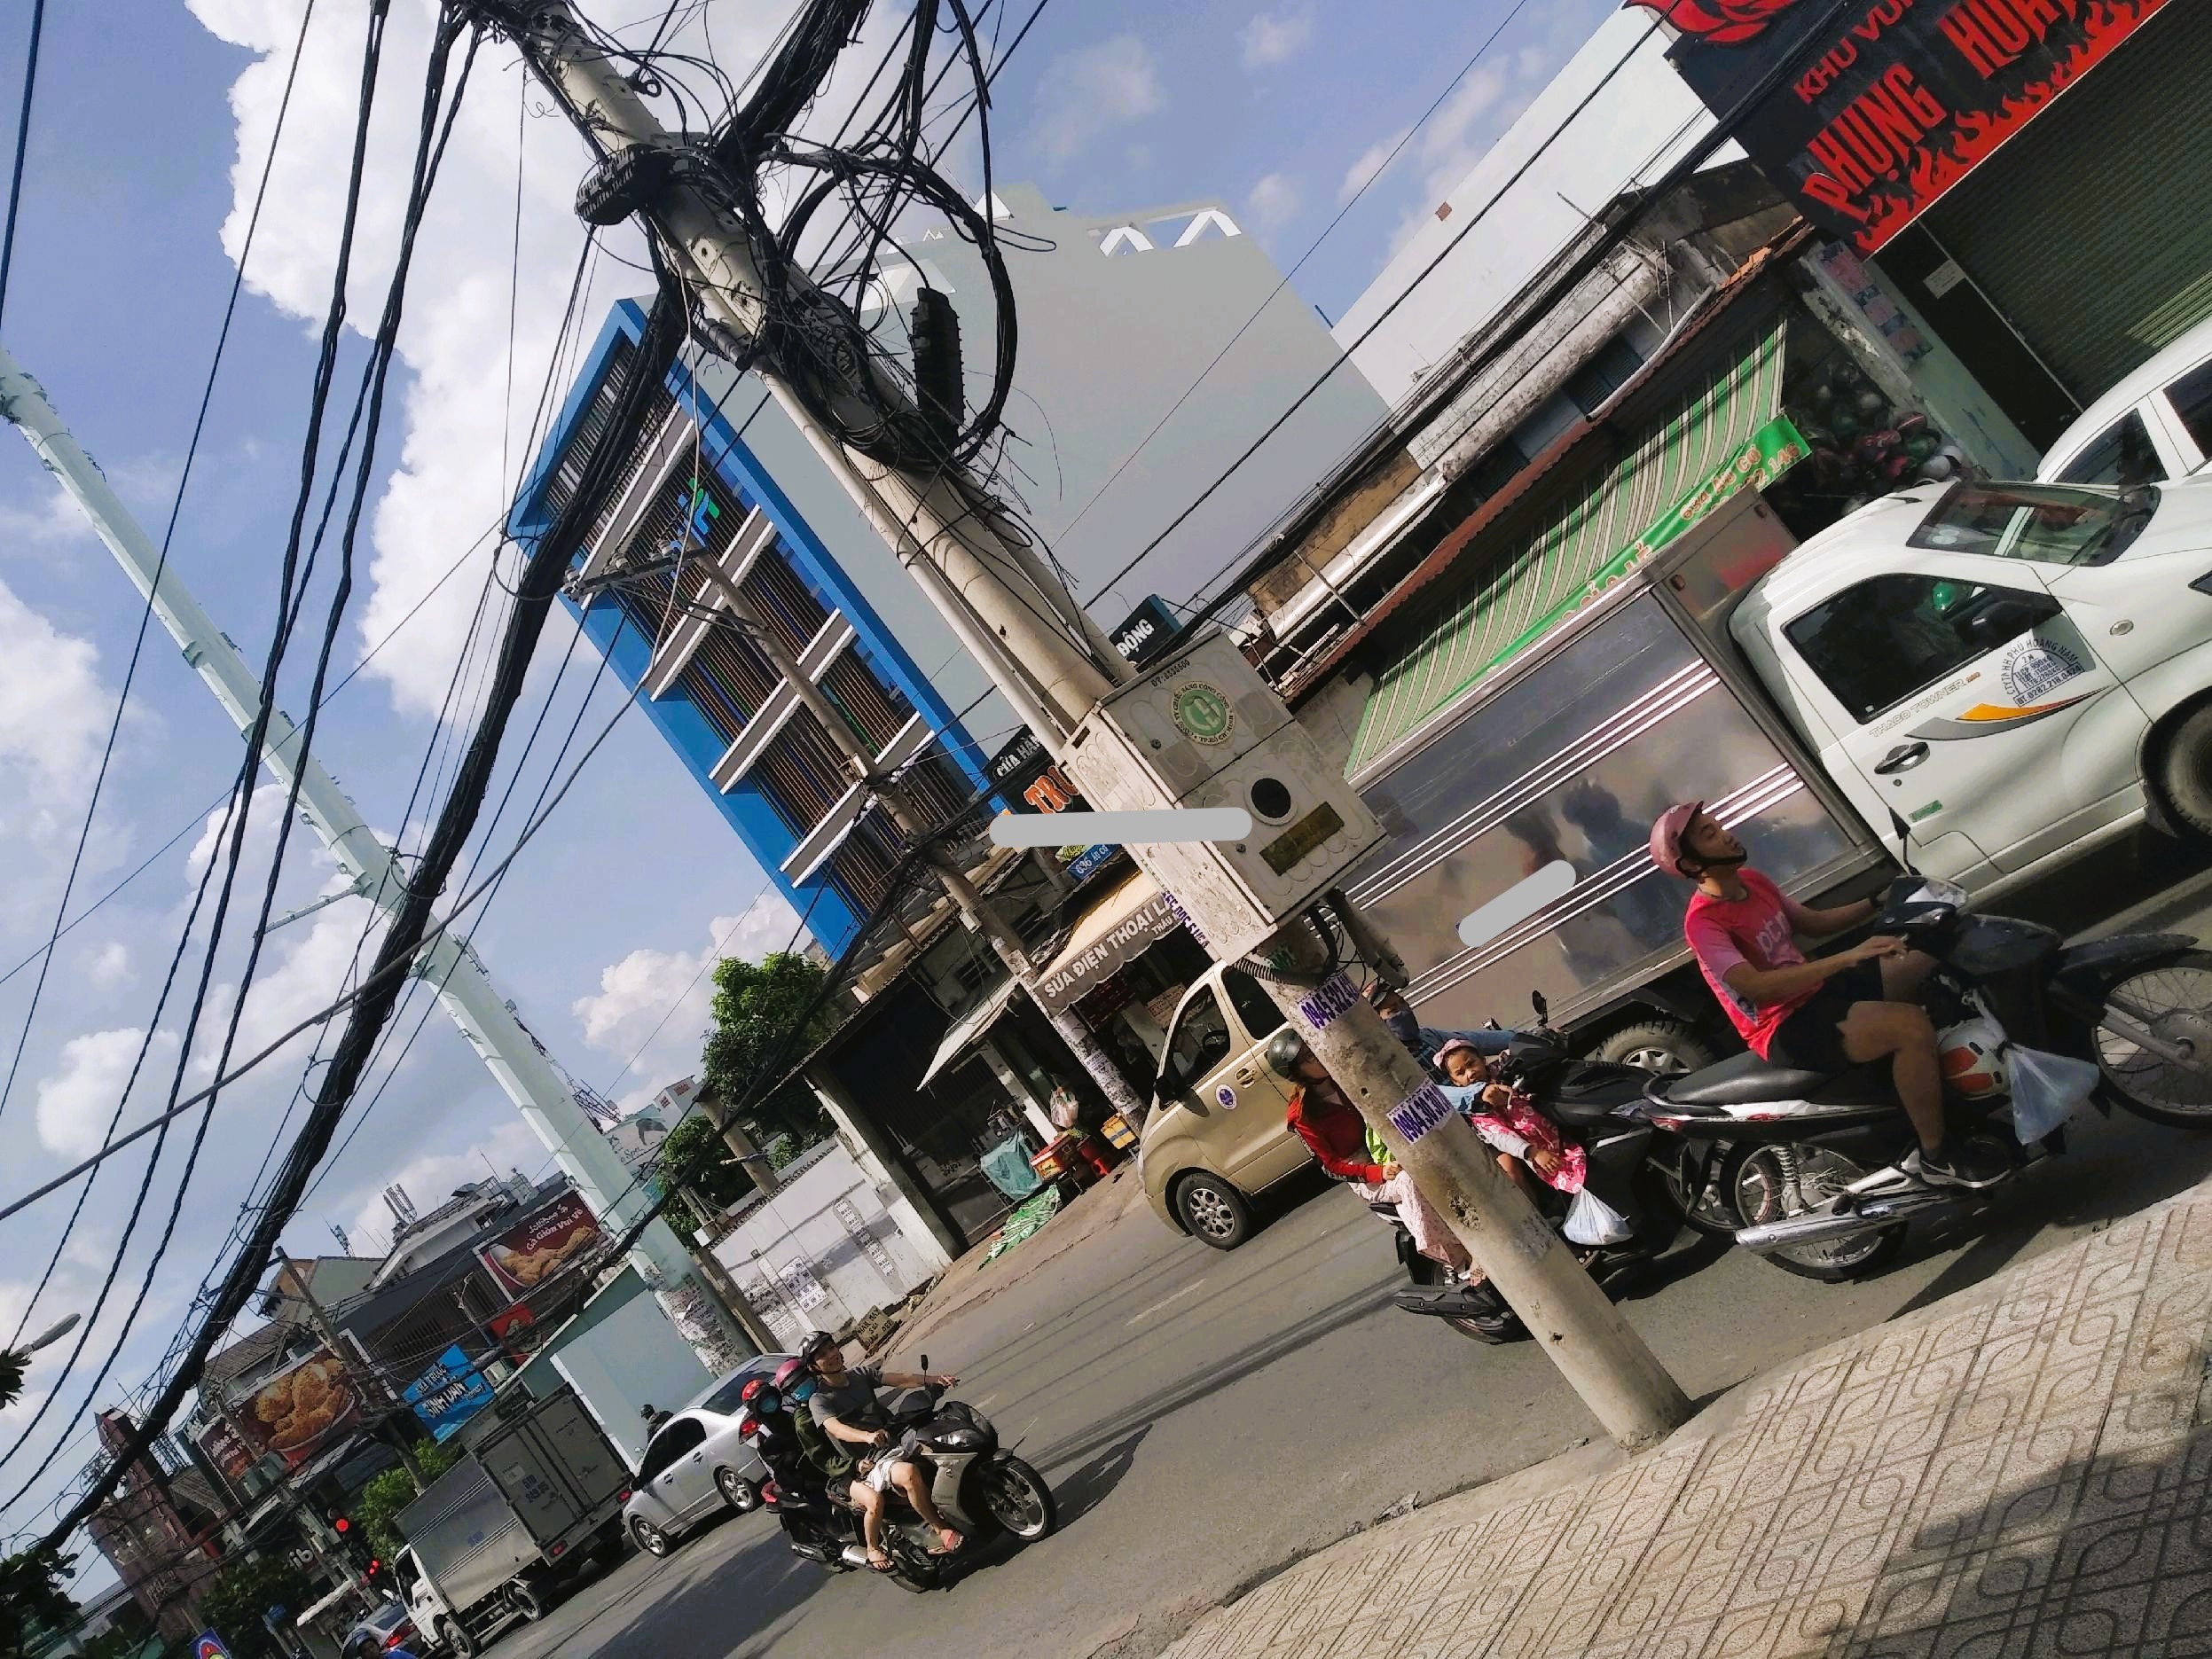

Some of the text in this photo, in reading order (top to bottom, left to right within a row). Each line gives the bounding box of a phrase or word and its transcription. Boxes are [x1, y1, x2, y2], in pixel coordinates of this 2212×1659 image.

[1793, 36, 1857, 106] KHU
[1801, 62, 1948, 223] PHỤNG
[1116, 618, 1155, 657] ĐỘNG
[1910, 678, 1967, 713] TOWNER
[996, 732, 1043, 778] CỬA HÀN
[1024, 765, 1080, 813] TRU
[1044, 970, 1075, 998] SỬA
[1071, 946, 1109, 977] ĐIỆN
[1106, 908, 1154, 951] THOẠI
